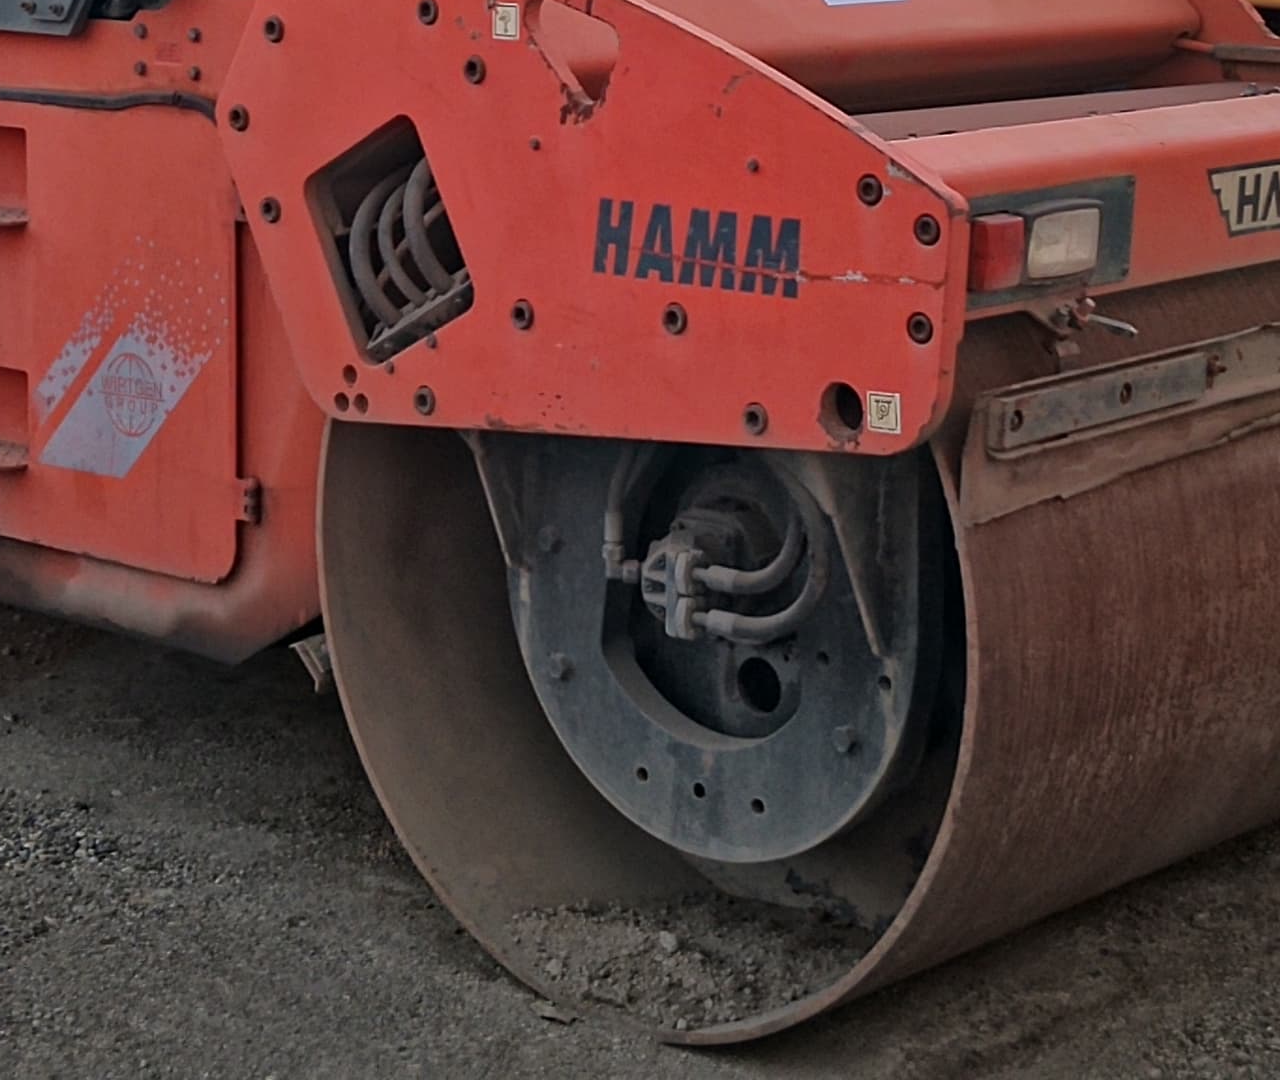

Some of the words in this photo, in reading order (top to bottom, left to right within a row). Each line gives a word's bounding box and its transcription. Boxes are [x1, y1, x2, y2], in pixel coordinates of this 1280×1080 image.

[592, 197, 801, 299] HAMM
[101, 375, 163, 400] WIRTGEN
[104, 396, 158, 416] GROUP
